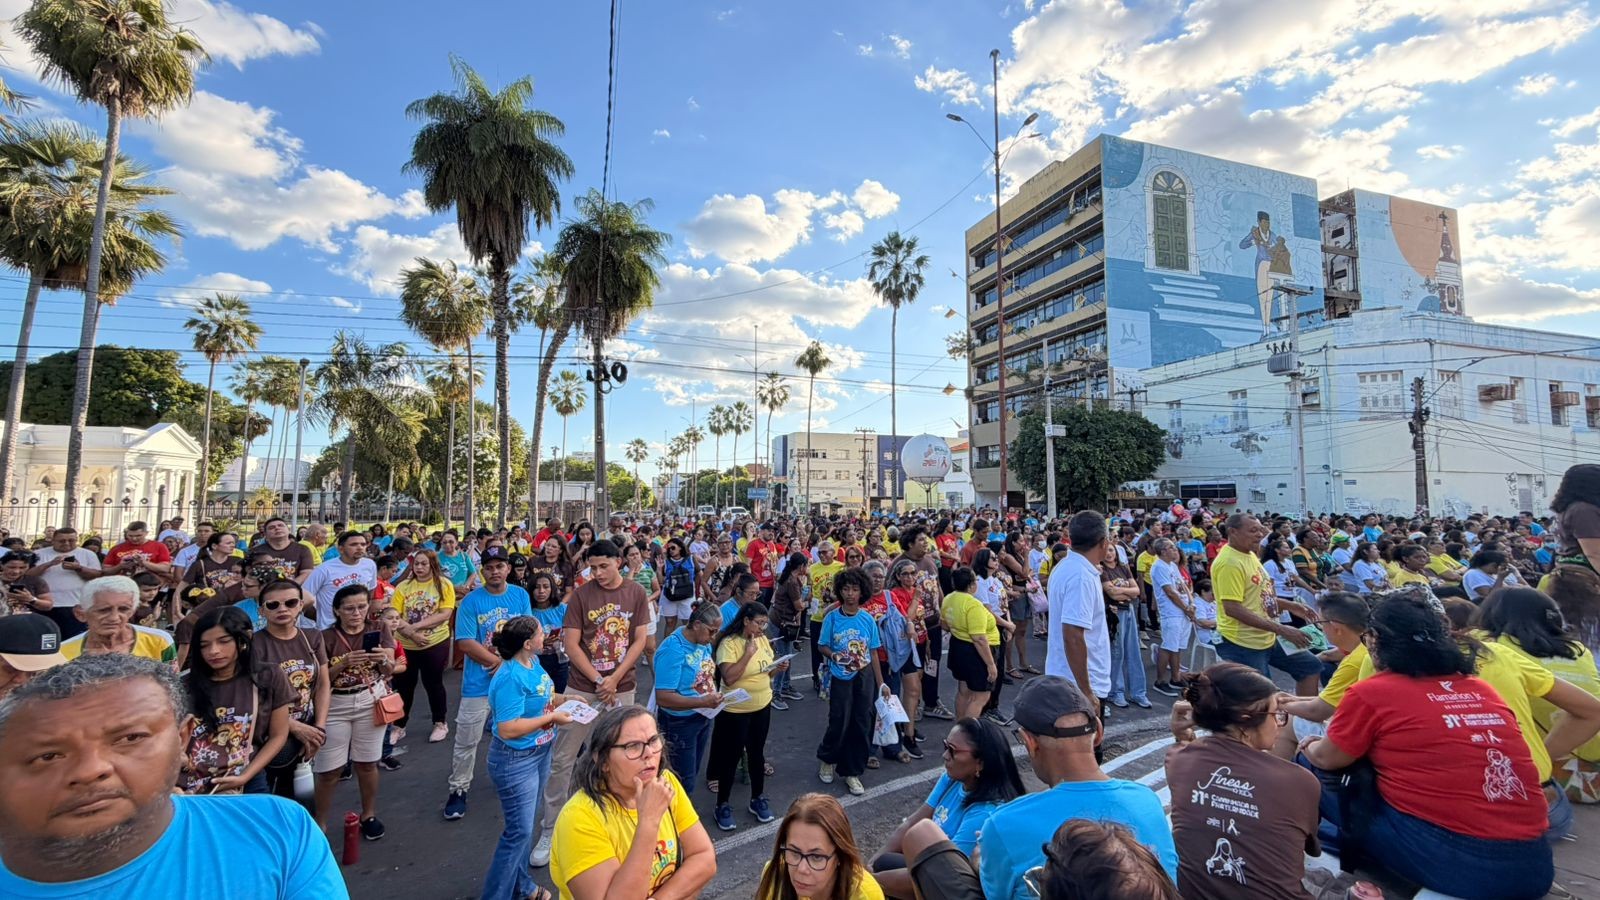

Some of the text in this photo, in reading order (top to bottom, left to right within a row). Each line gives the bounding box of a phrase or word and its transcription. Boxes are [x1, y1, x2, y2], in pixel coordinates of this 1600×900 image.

[588, 603, 615, 621] AMOR
[280, 659, 297, 669] MOR
[1426, 692, 1473, 702] Flamarion
[1197, 766, 1255, 790] finess
